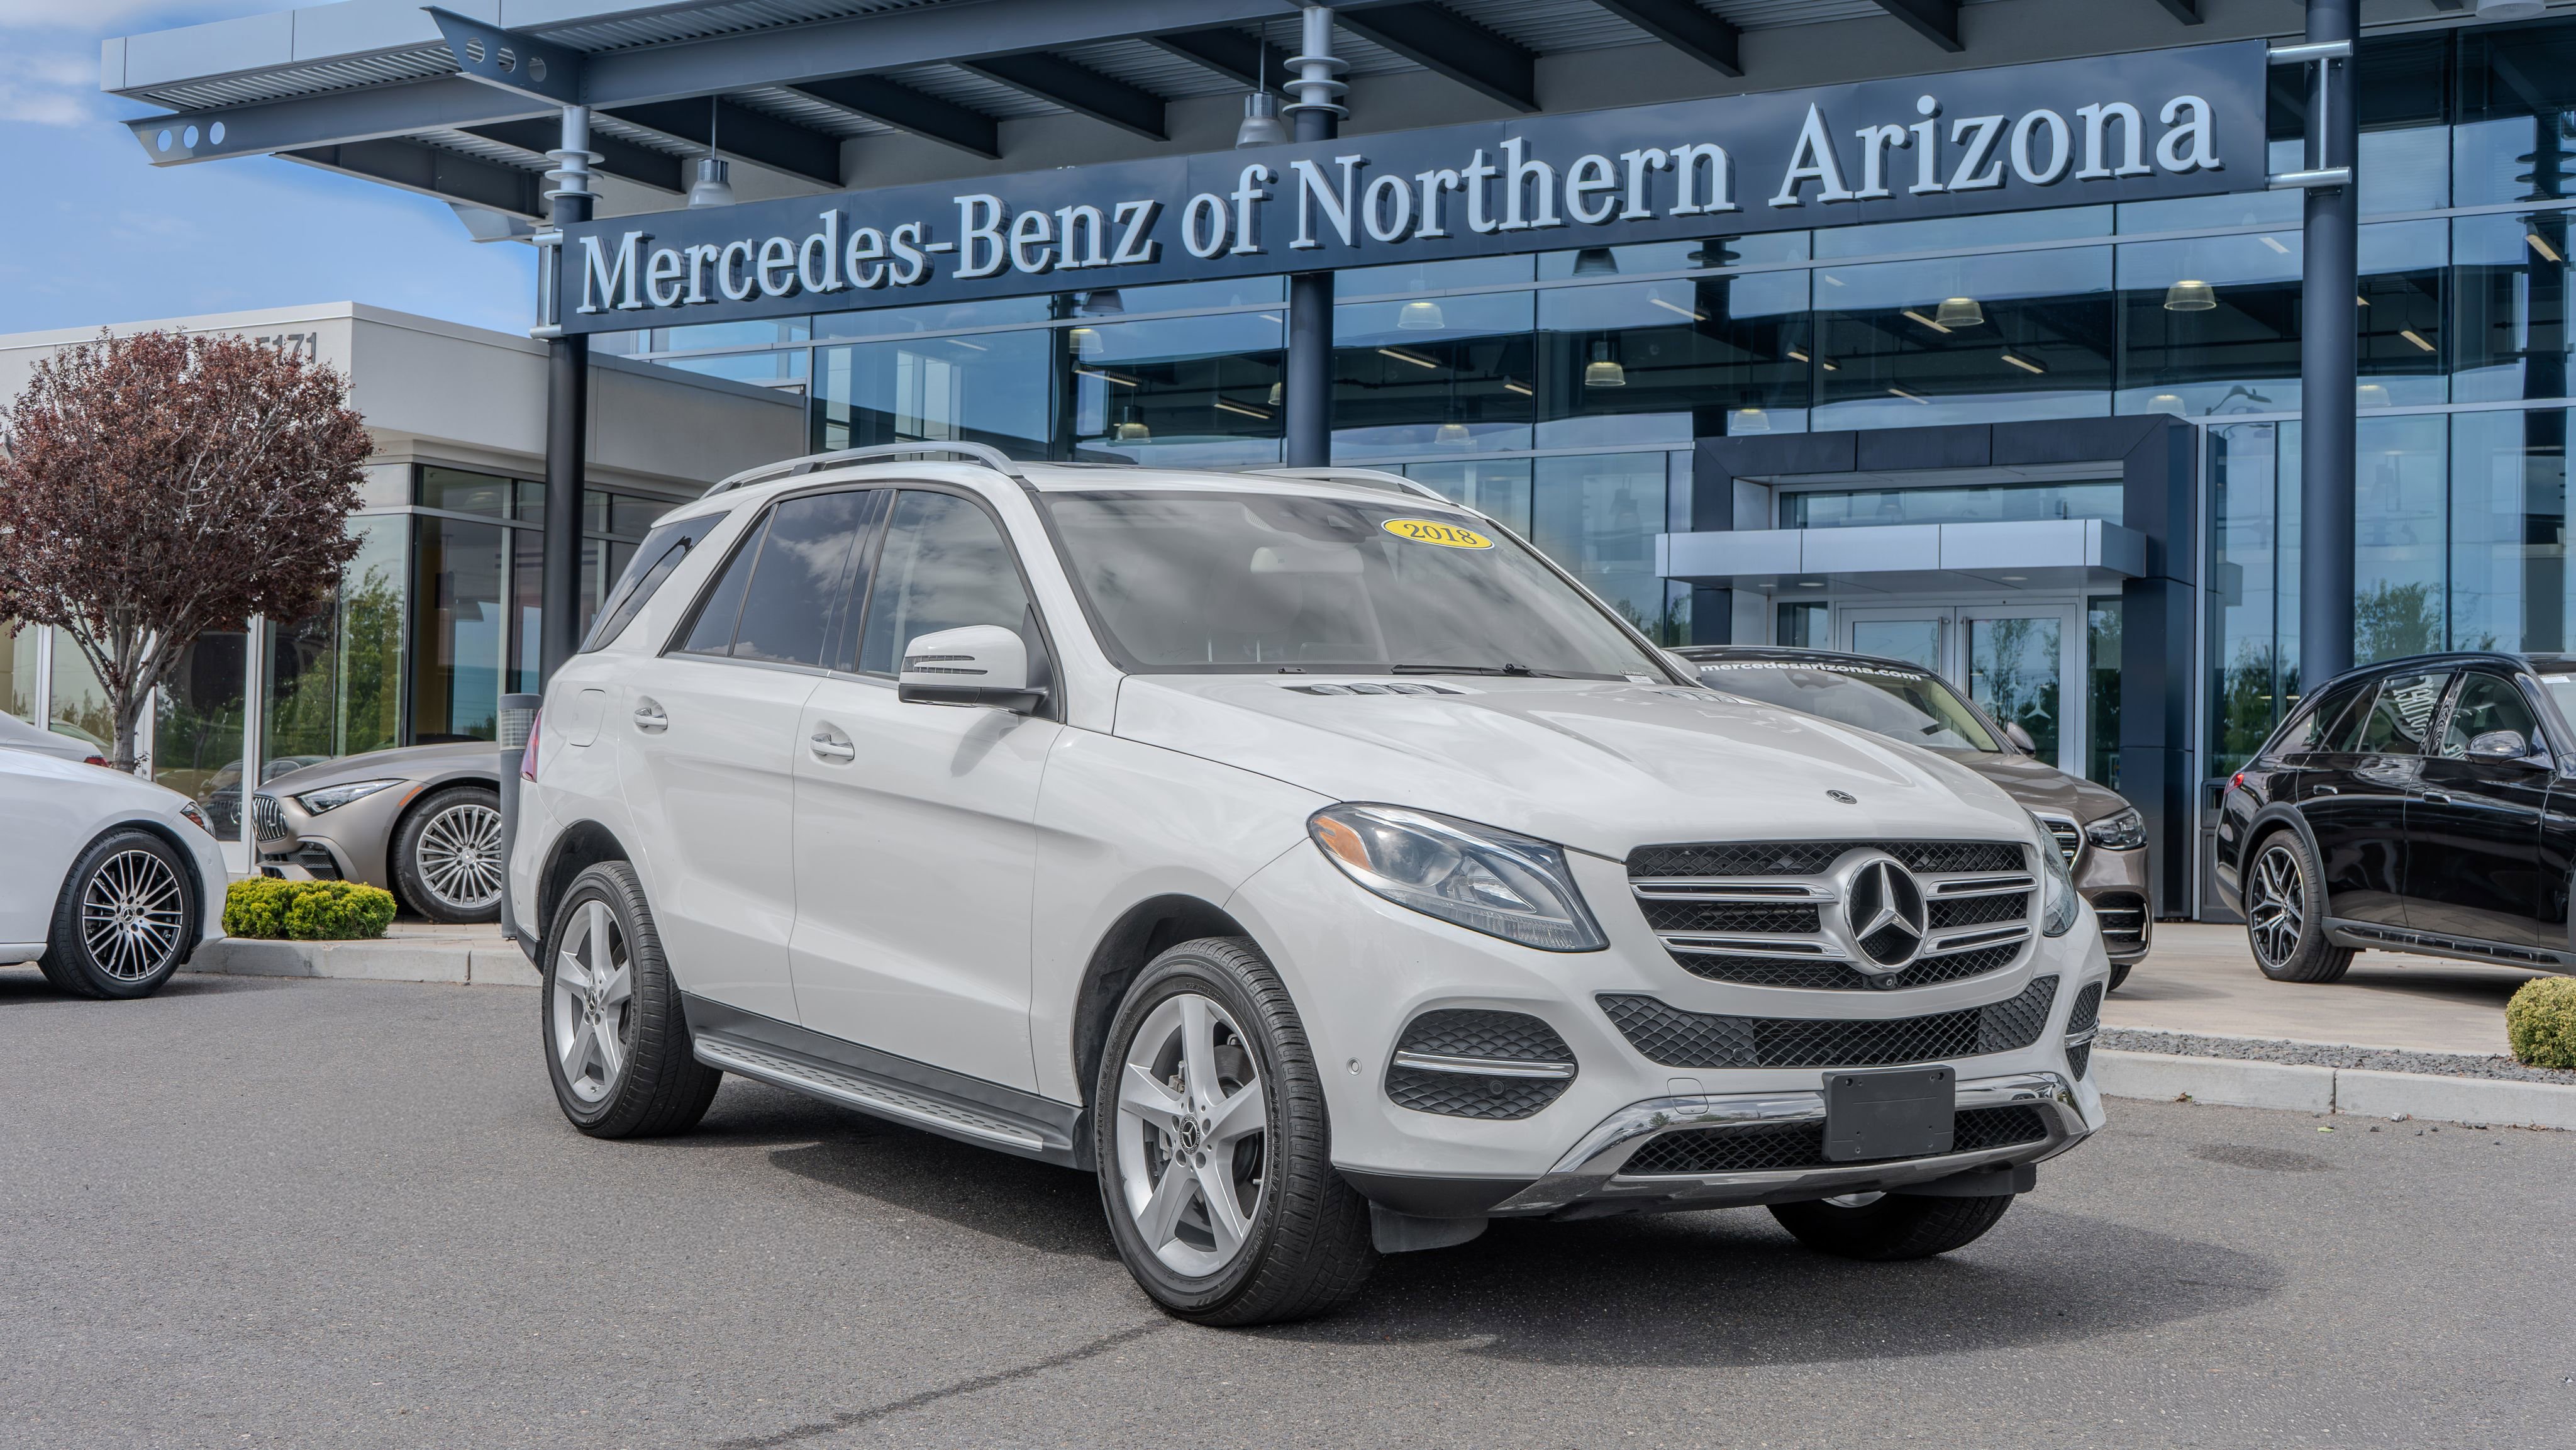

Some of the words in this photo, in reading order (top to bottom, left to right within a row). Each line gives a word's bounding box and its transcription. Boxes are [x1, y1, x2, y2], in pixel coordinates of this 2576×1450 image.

[576, 193, 1163, 315] Mercedes-Benz
[1181, 164, 1279, 259] of
[1289, 137, 1743, 250] Northern
[1768, 95, 2224, 209] Arizona
[1403, 523, 1477, 545] 2018
[1699, 662, 1922, 681] mercedesarizona.com
[1269, 1096, 1281, 1195] YOKOHAMA
